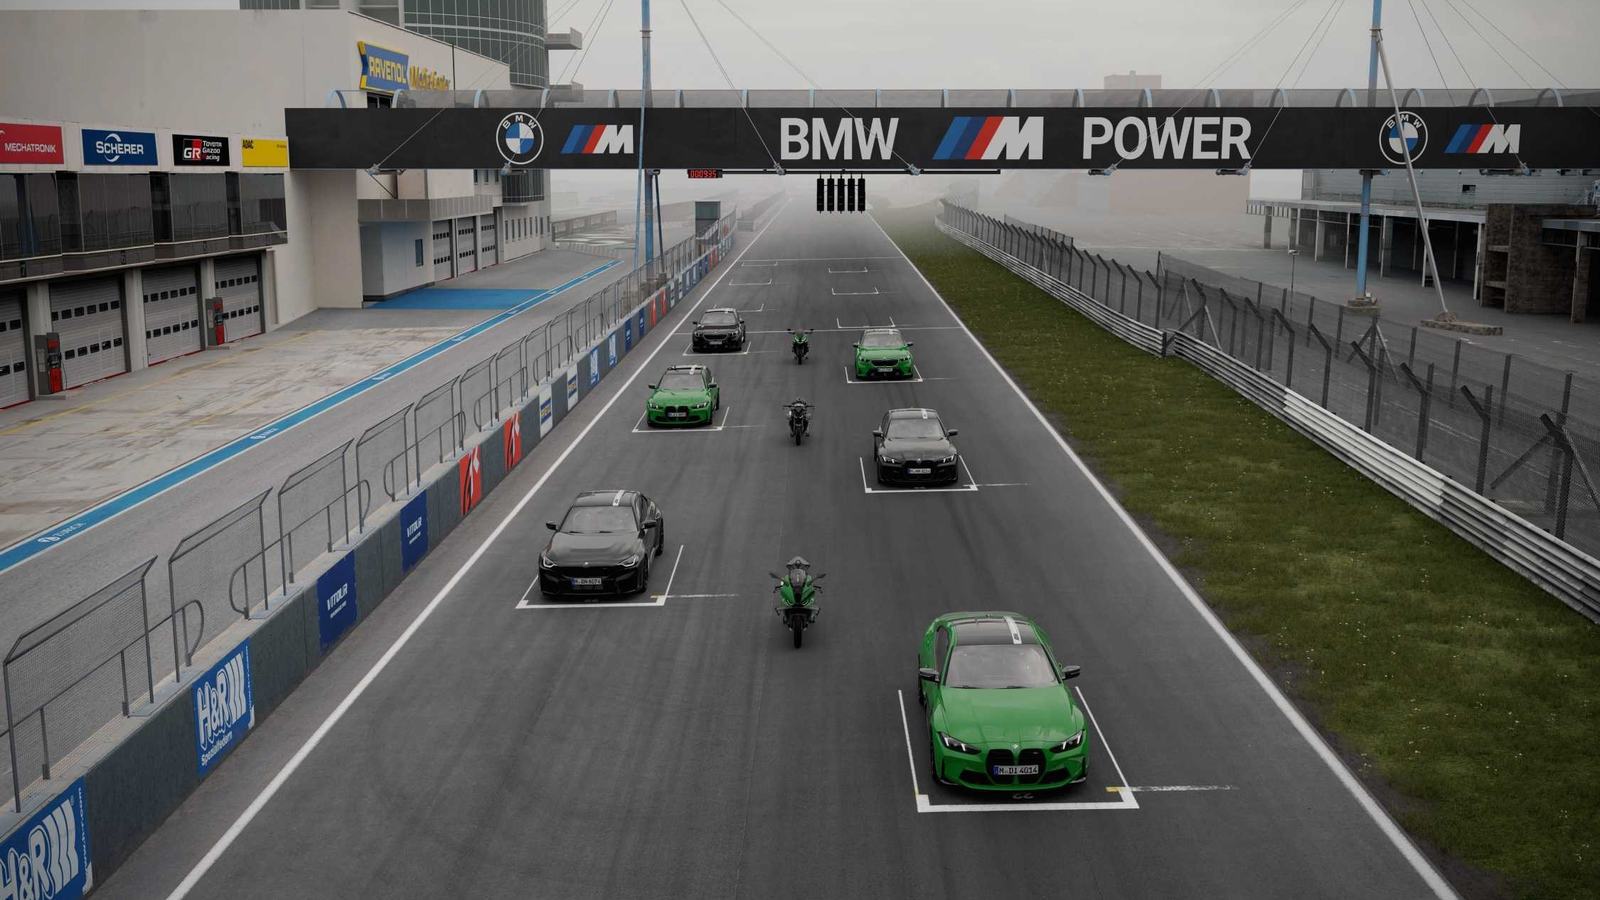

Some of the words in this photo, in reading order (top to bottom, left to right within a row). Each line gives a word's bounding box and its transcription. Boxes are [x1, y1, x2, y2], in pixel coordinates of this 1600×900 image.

[368, 56, 406, 84] RAVENOL
[4, 142, 57, 153] MECHATRONIK
[95, 141, 144, 155] SCHERER
[592, 124, 634, 154] M
[780, 117, 900, 160] BMW
[980, 116, 1044, 160] M
[1082, 116, 1252, 160] POWER
[1476, 123, 1521, 154] M
[183, 147, 201, 159] GR
[196, 668, 233, 750] H&R
